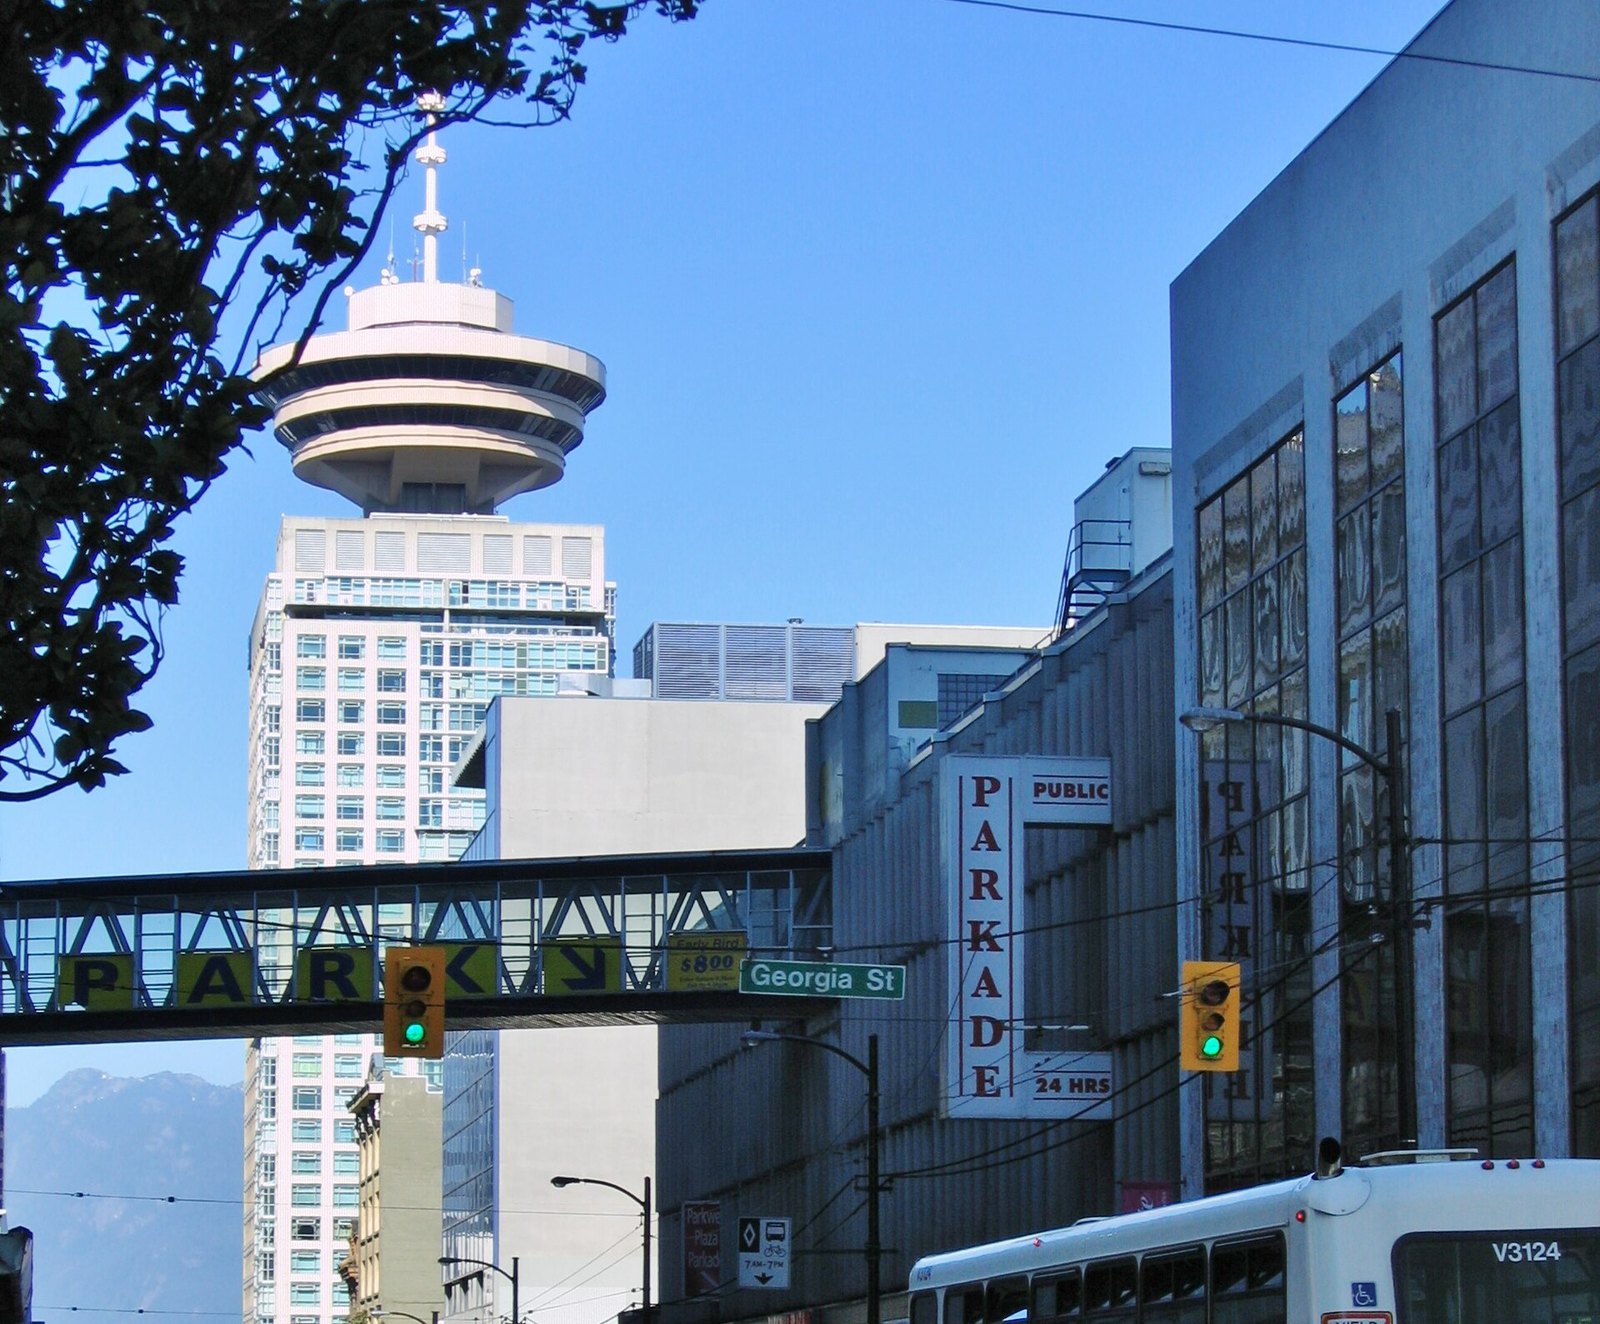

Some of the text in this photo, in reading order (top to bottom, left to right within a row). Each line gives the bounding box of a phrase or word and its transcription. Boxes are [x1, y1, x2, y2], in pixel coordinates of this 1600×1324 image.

[1033, 782, 1109, 799] PUBLIC
[713, 938, 739, 949] Bird
[967, 776, 1004, 1098] PARKADE
[750, 964, 895, 992] Georgia St
[1036, 1077, 1111, 1094] 24 HRS
[694, 1230, 718, 1245] Plaza
[1492, 1242, 1562, 1262] V3124
